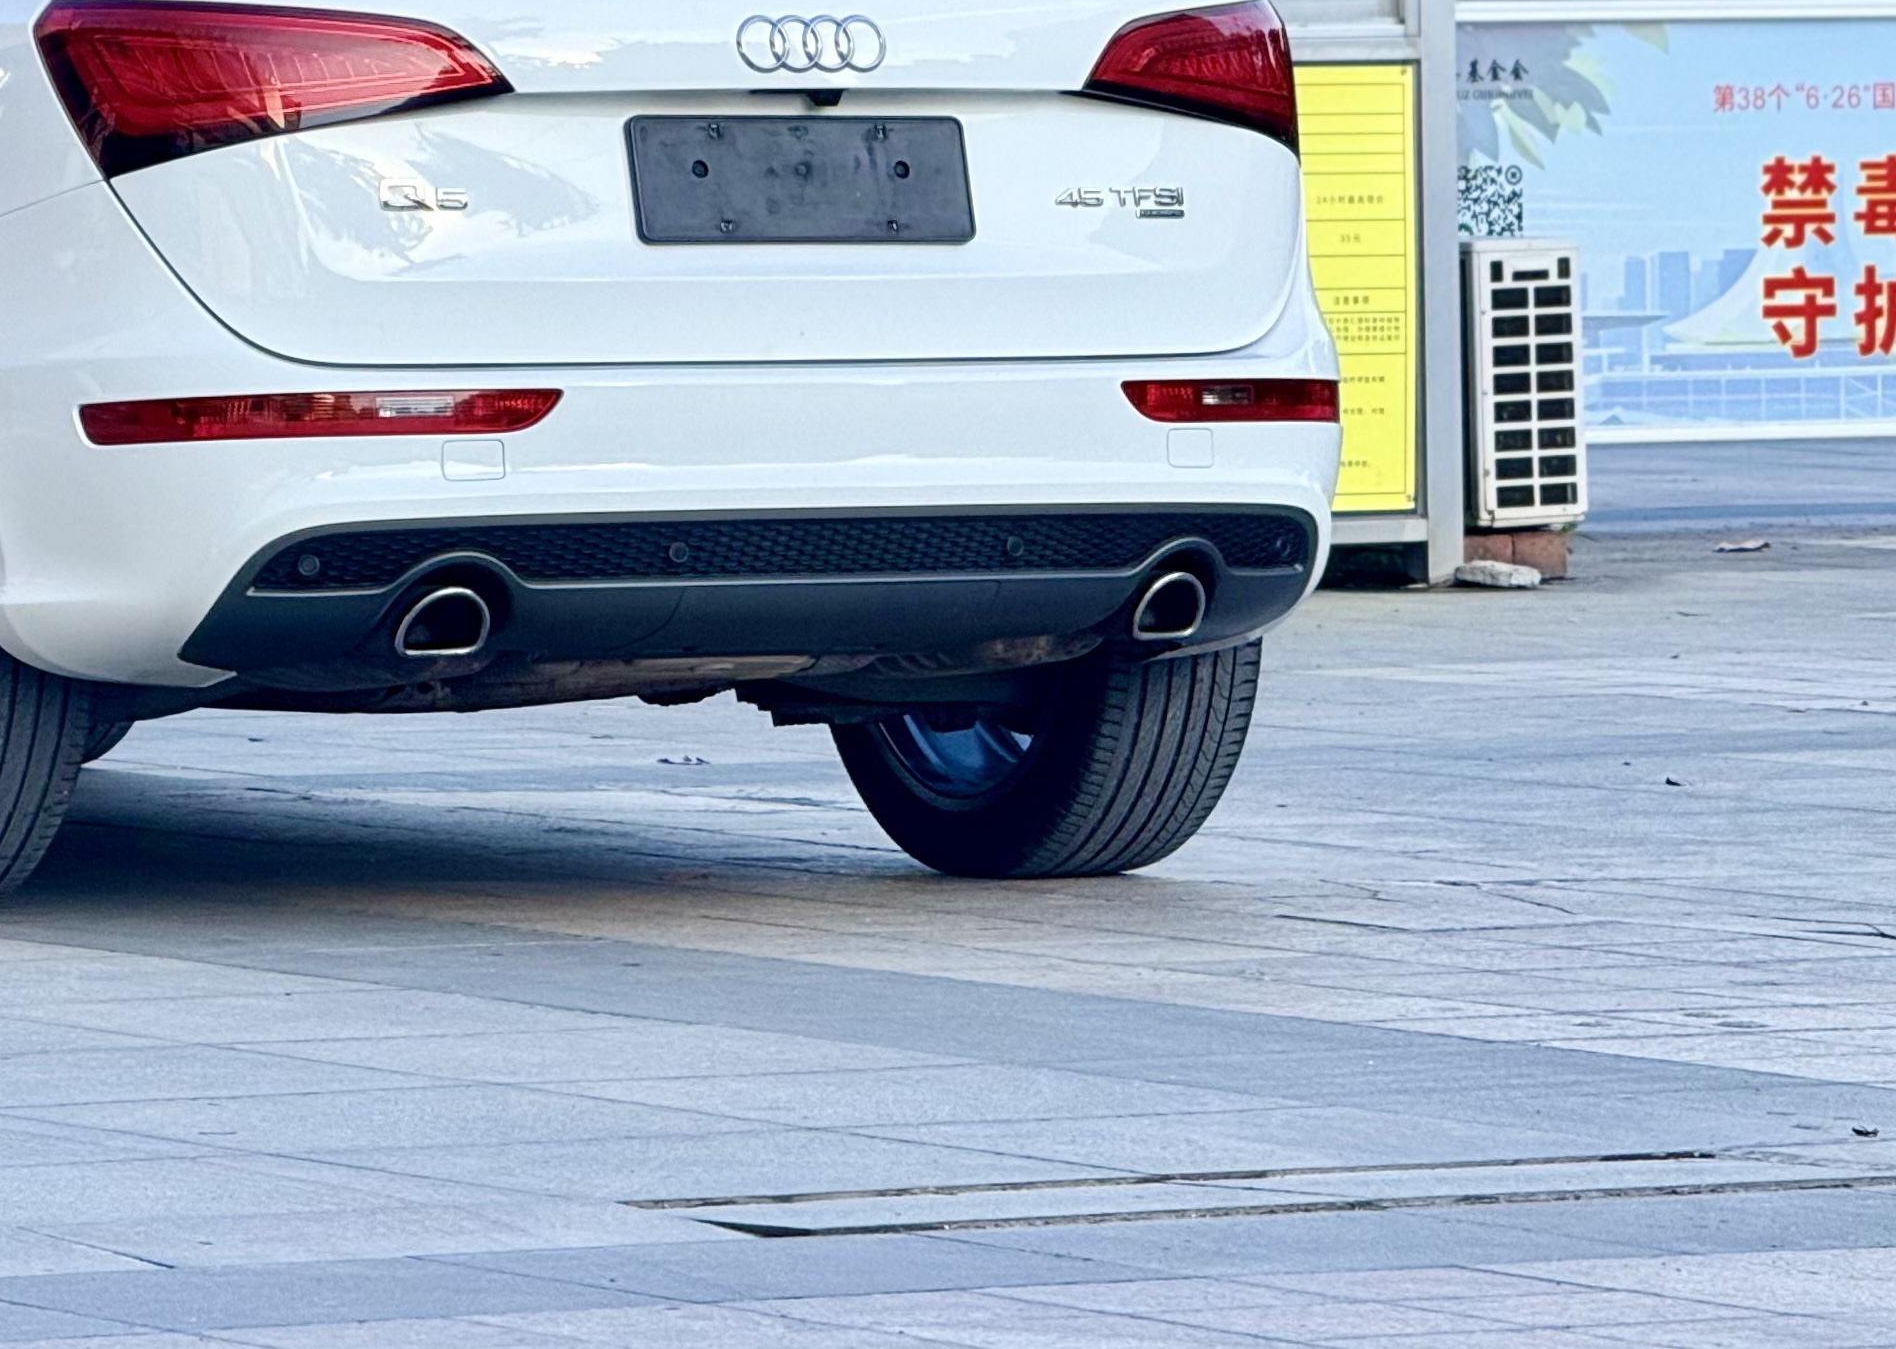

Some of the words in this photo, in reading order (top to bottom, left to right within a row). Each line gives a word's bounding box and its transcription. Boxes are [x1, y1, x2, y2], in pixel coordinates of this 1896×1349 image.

[1456, 58, 1529, 83] 基金会
[379, 178, 469, 212] Q5
[1055, 186, 1104, 208] 45
[1109, 186, 1185, 208] TFSI
